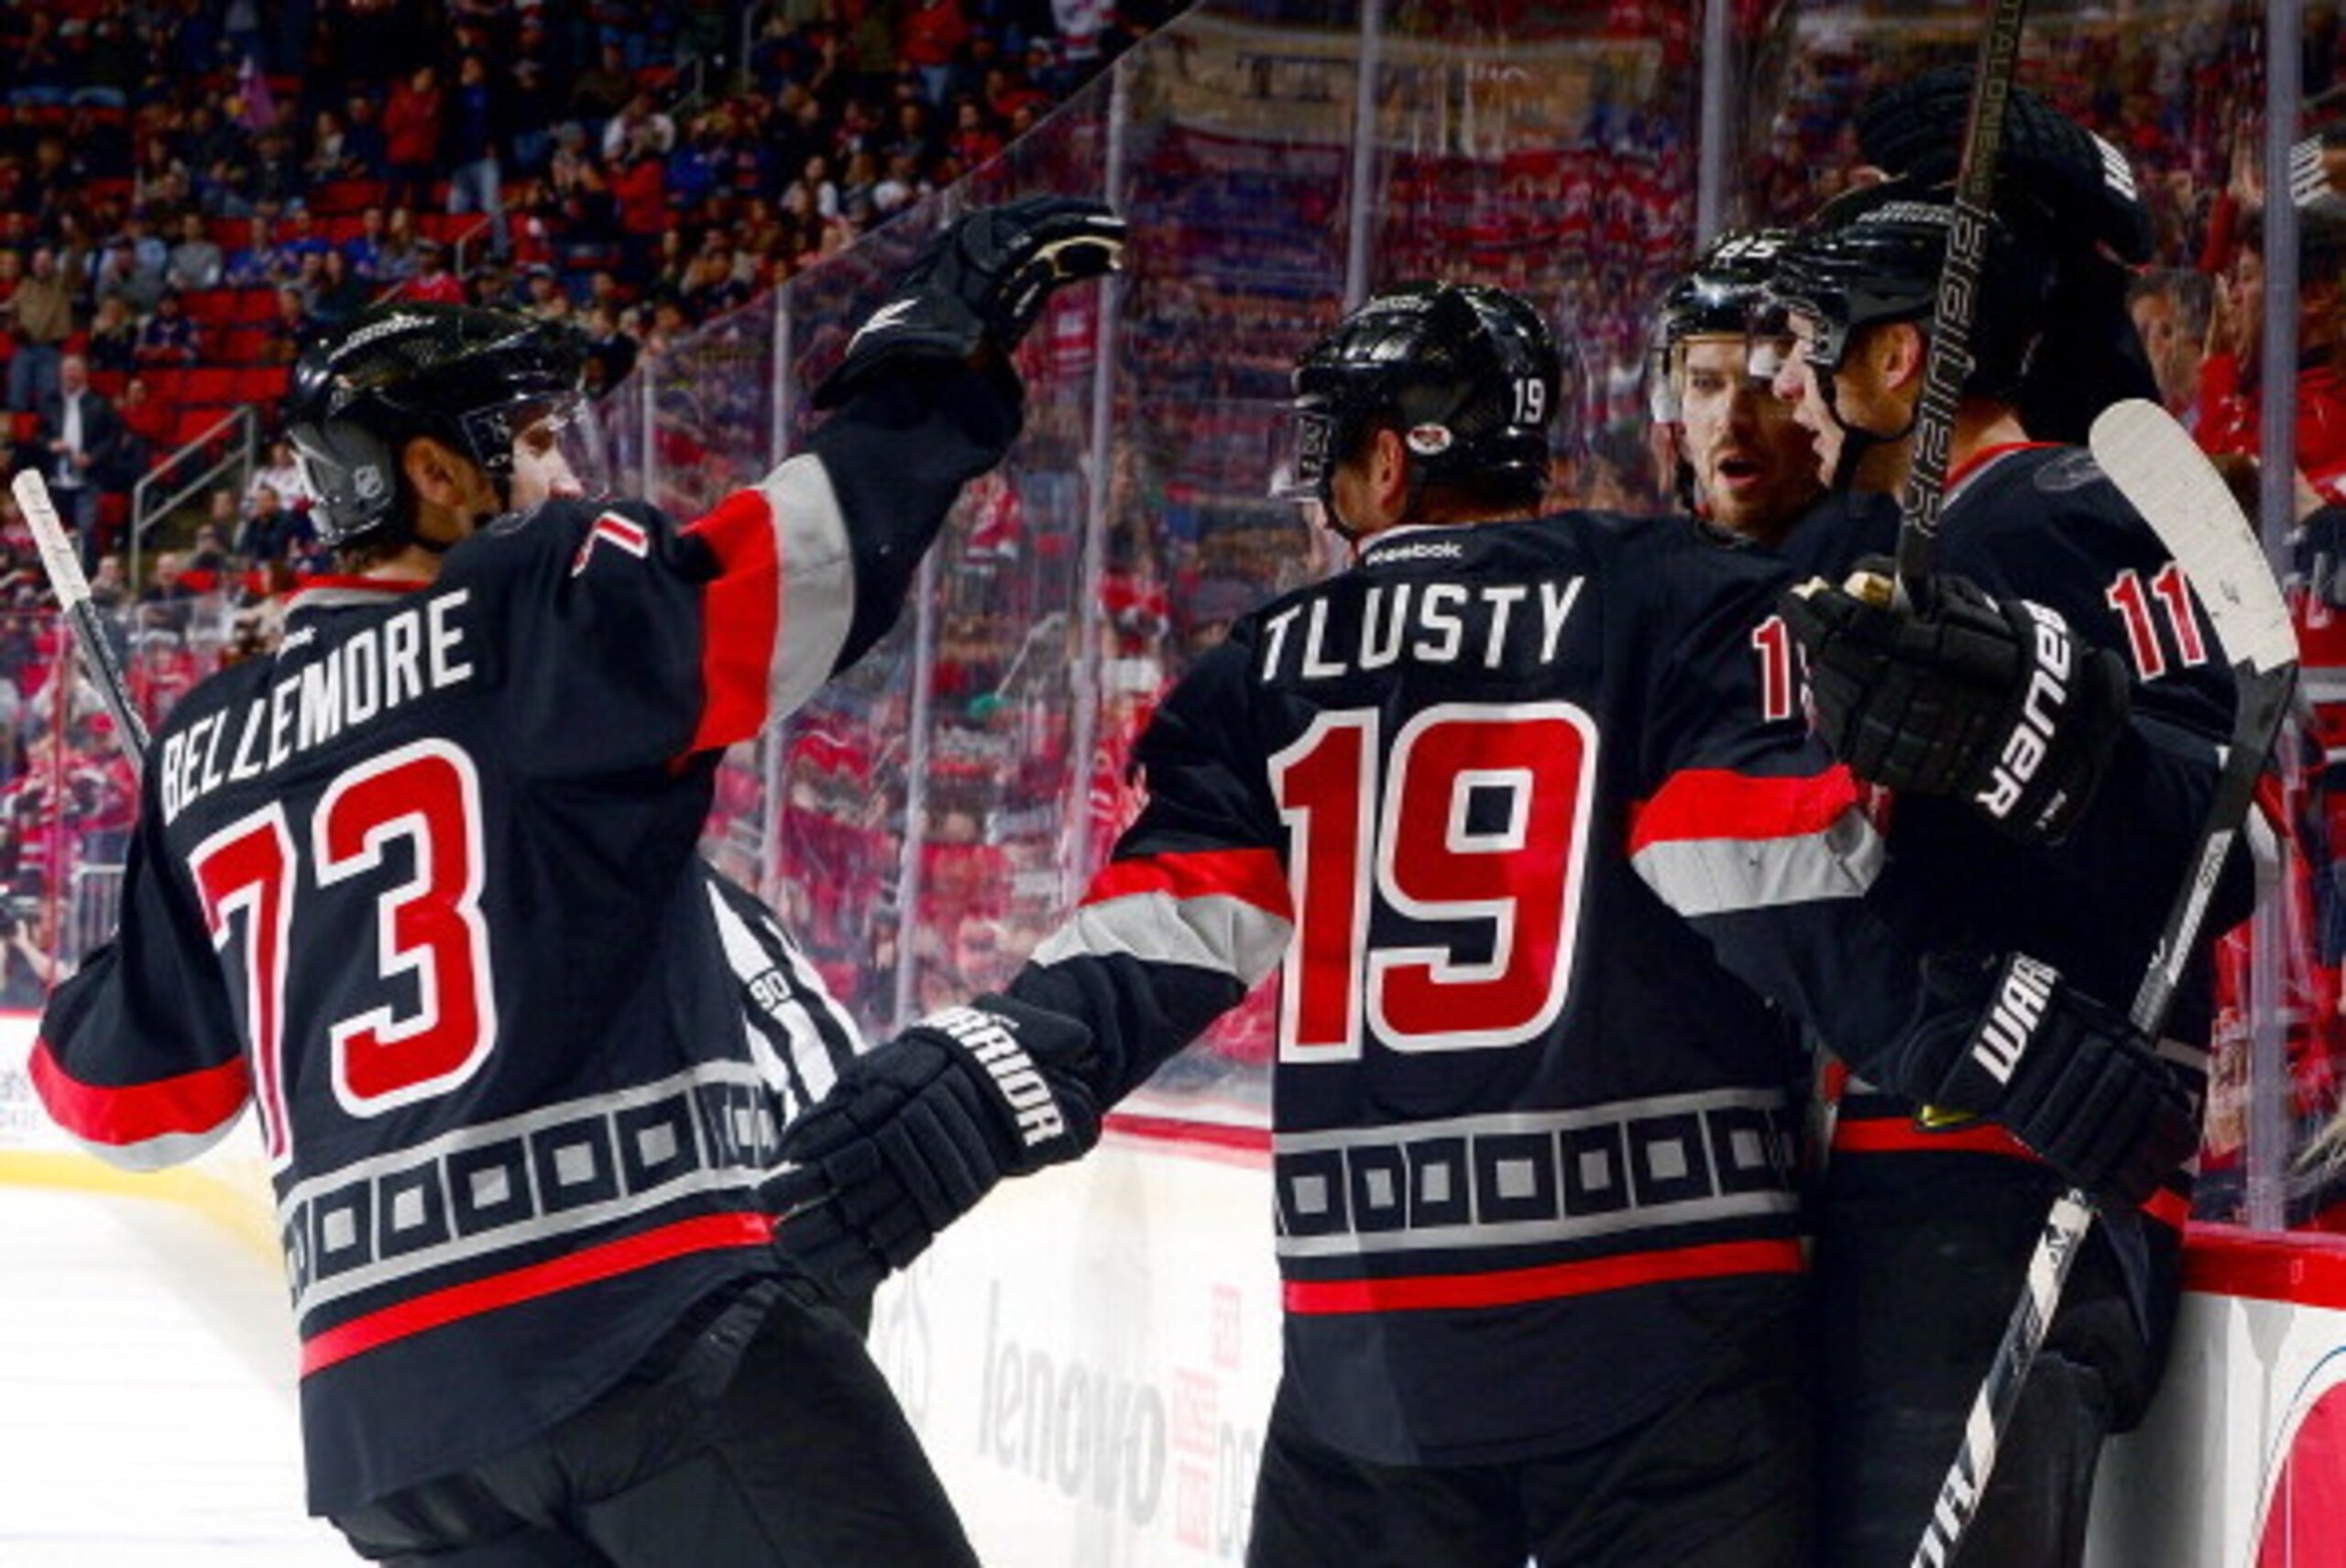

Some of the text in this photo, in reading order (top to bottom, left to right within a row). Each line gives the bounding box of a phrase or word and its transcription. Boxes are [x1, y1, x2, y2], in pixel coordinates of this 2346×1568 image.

[1512, 378, 1546, 423] 19
[160, 587, 474, 827] BELLEMORE
[1263, 576, 1585, 682] TLUSTY
[1975, 598, 2071, 817] BAUER
[2104, 561, 2208, 684] 11
[188, 738, 499, 1175] 73
[750, 970, 792, 1012] 90
[1266, 700, 1600, 1064] 19
[979, 1278, 1166, 1527] lenovo
